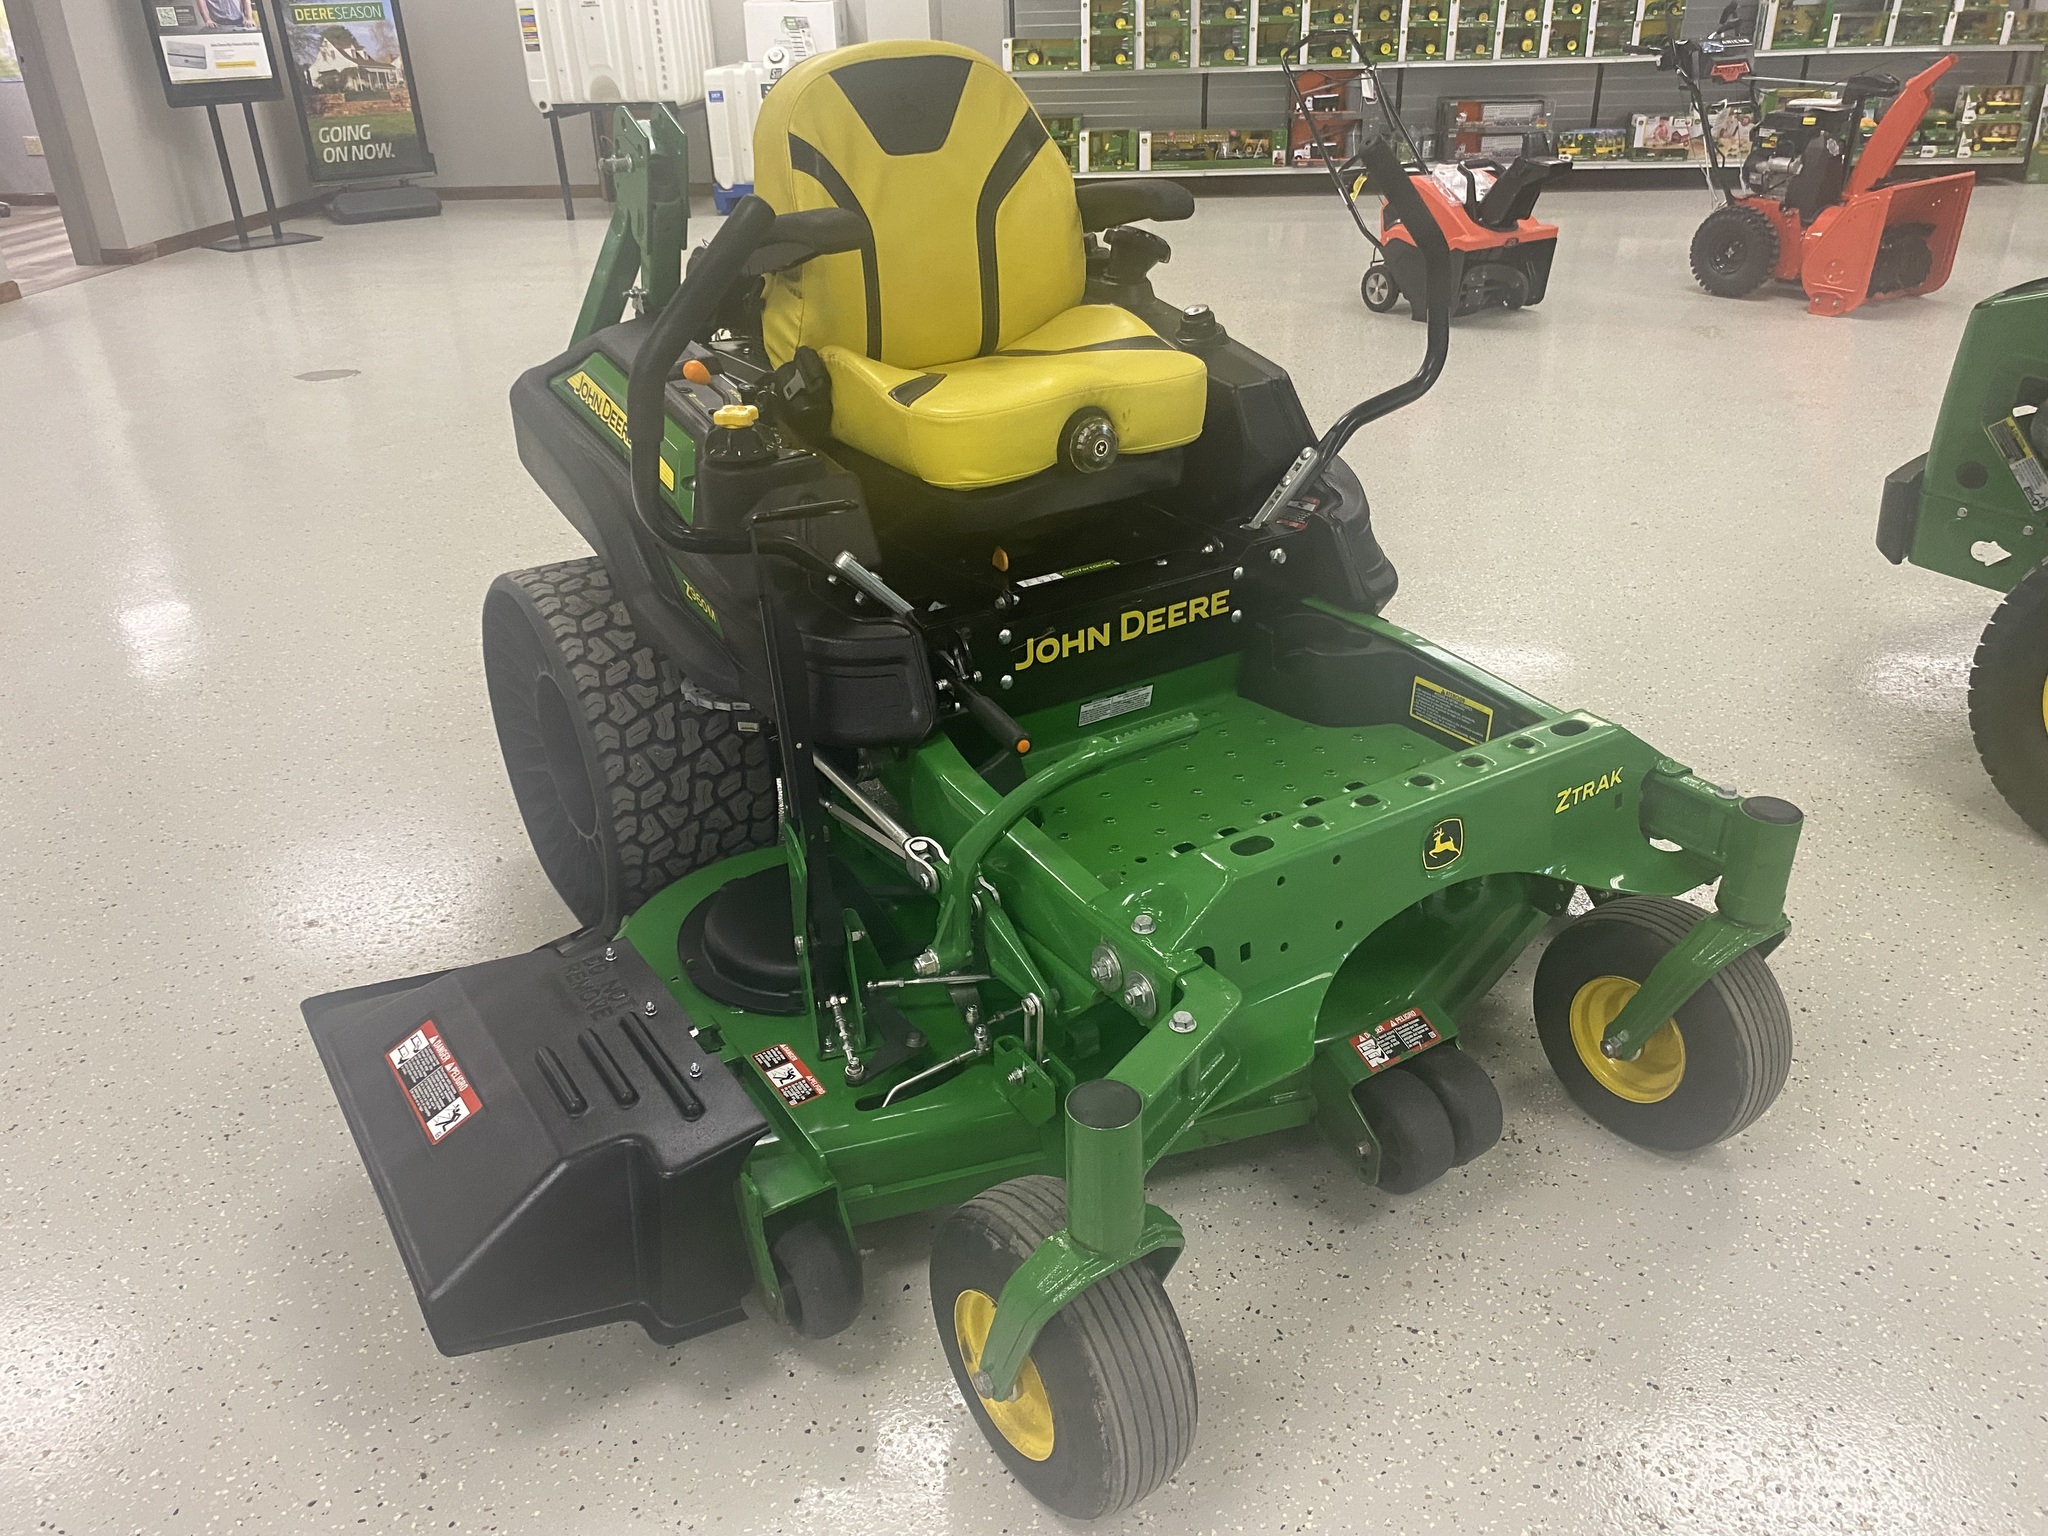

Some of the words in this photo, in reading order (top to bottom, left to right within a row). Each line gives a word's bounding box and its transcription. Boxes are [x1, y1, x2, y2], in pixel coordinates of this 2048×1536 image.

[318, 124, 371, 143] GOING
[323, 147, 348, 163] ON
[351, 142, 396, 161] NOW.
[575, 375, 602, 415] JOHN
[602, 398, 632, 447] DEER
[1015, 622, 1111, 671] JOHN
[1120, 589, 1230, 642] DEERE
[1554, 765, 1624, 815] ZTRAK
[434, 1040, 451, 1063] DANGER
[450, 1067, 469, 1092] PELIGRO
